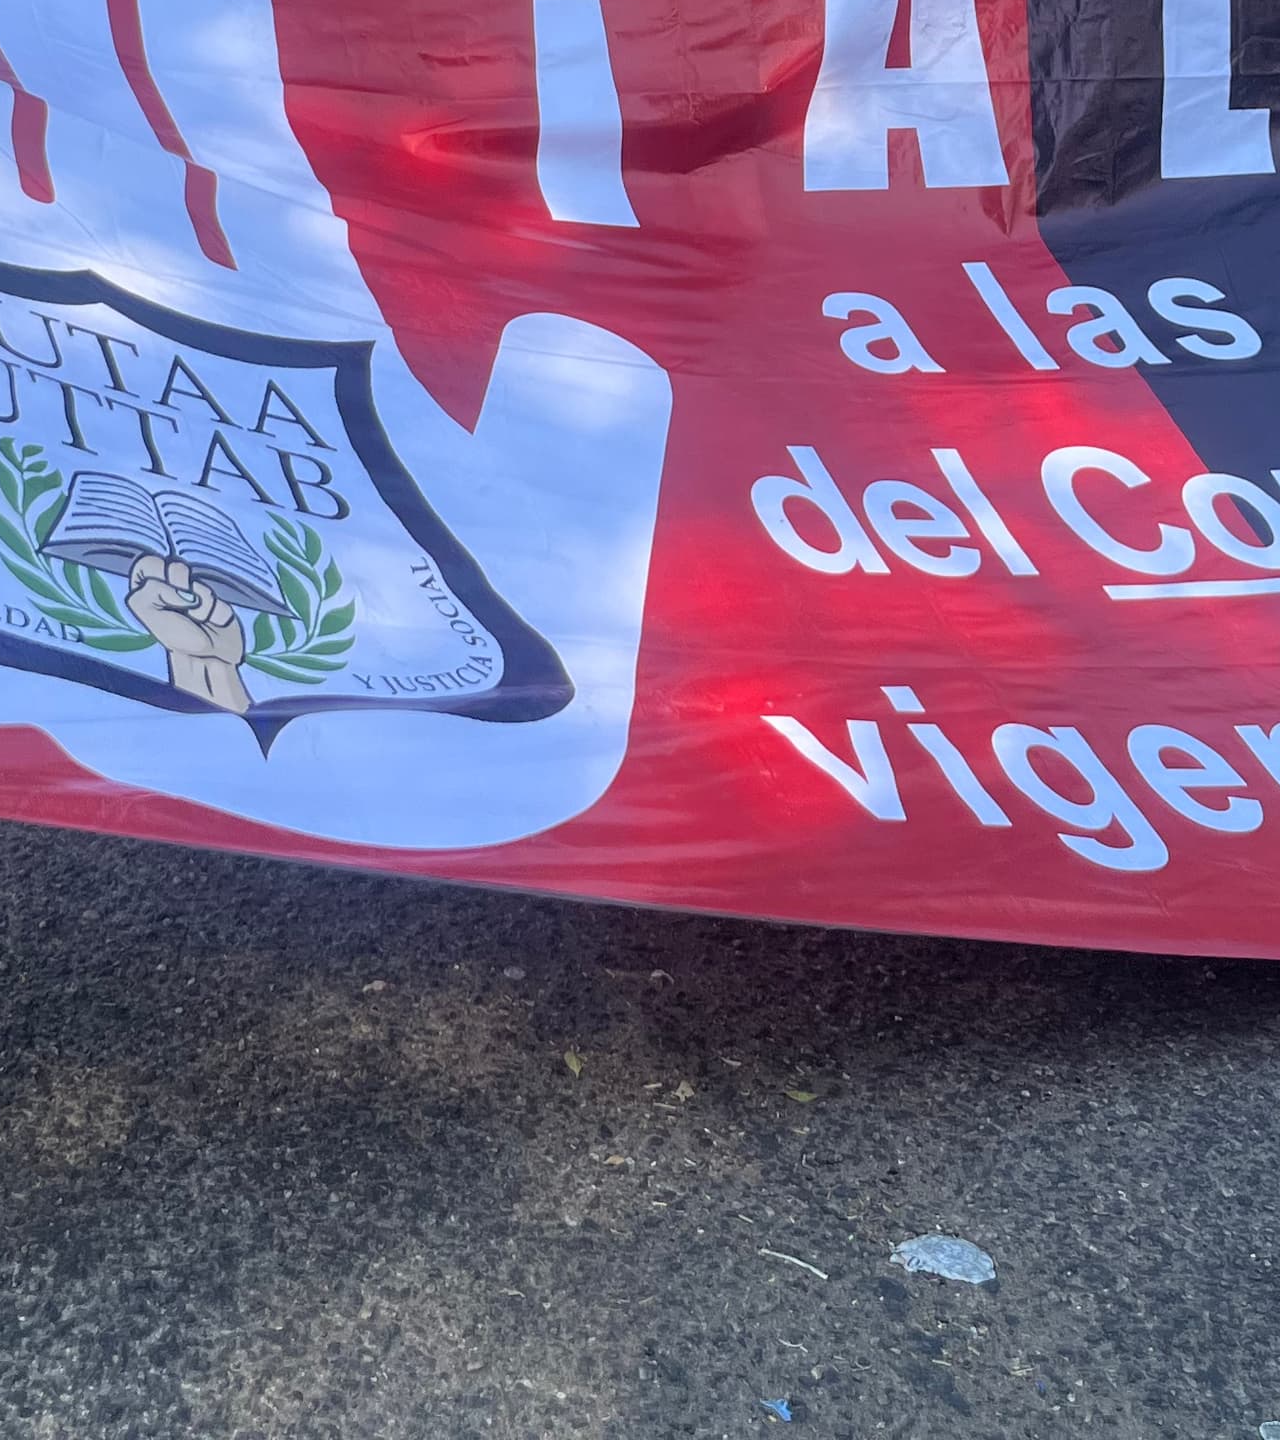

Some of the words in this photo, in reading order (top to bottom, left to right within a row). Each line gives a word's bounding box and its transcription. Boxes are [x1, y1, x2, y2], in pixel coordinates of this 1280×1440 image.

[821, 290, 947, 375] a
[962, 261, 1264, 372] las
[750, 445, 1041, 578] del
[410, 556, 488, 649] SOCIAL
[379, 655, 493, 696] JUSTICIA
